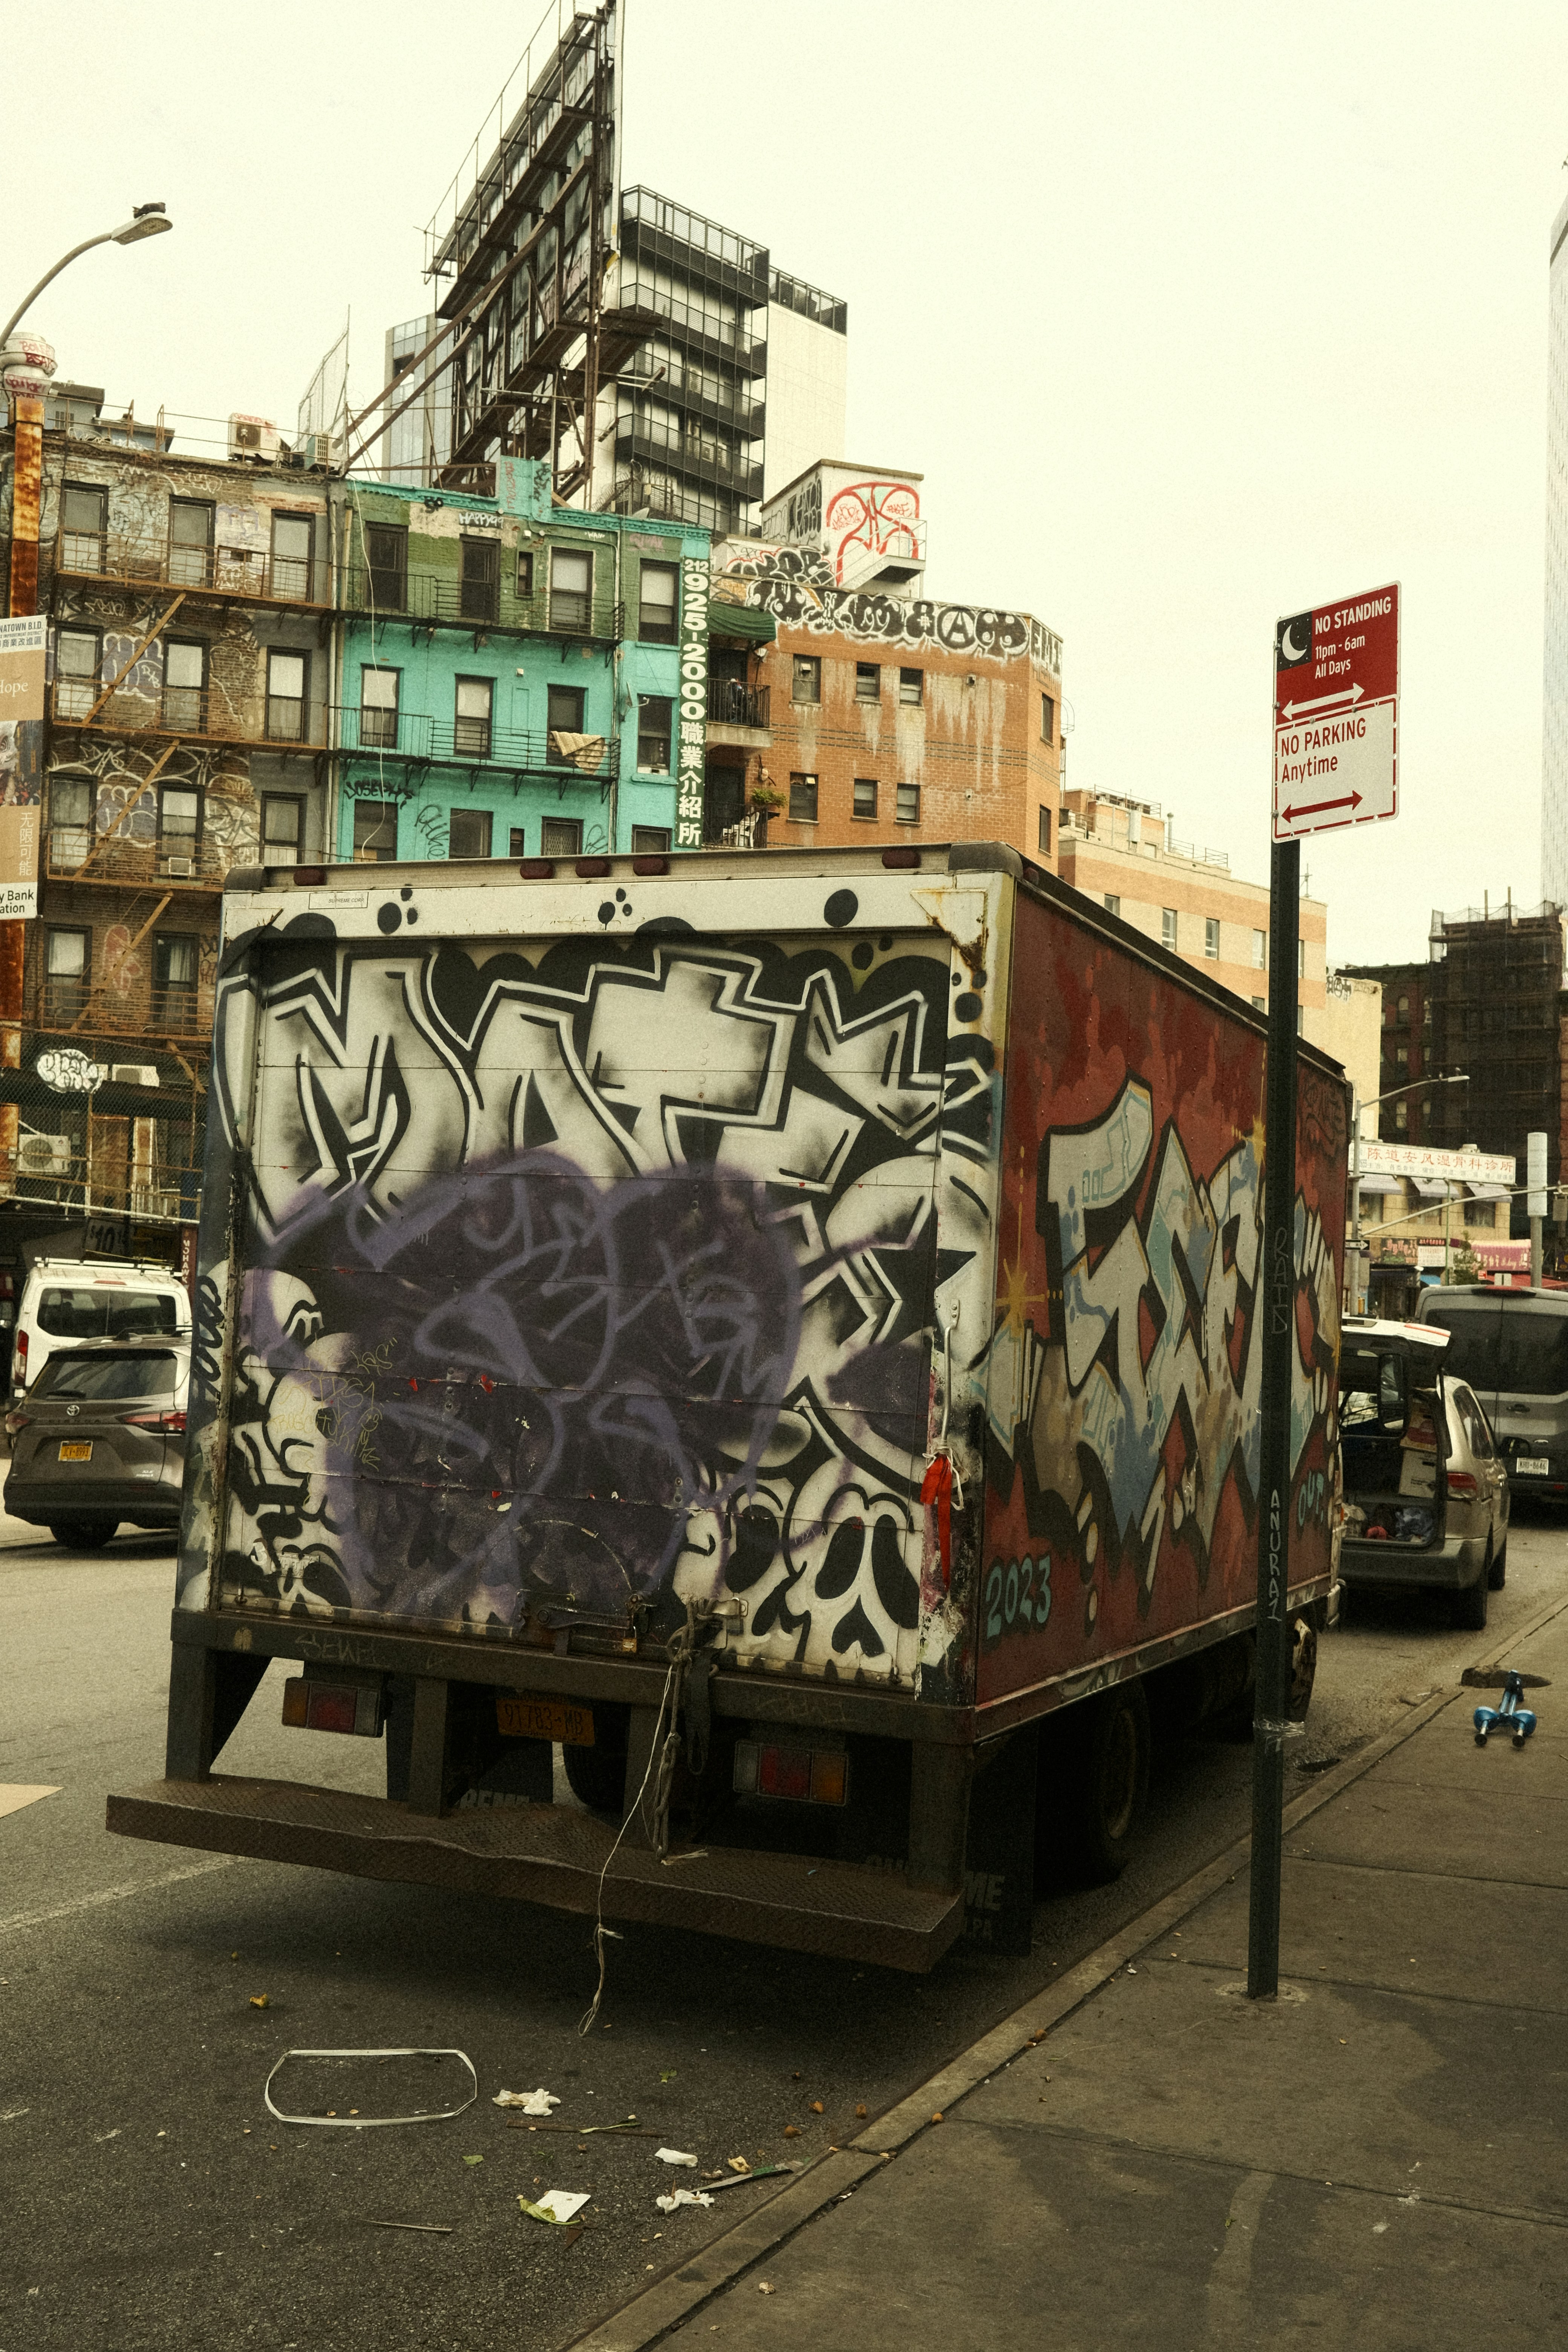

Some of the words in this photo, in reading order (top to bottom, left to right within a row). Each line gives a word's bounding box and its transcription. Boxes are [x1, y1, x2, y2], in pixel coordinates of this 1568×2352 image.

[684, 559, 709, 572] 212
[1315, 615, 1331, 635] NO
[1334, 596, 1391, 629] STANDING
[681, 573, 709, 720] 925-2000
[1315, 644, 1336, 661] 11pm
[1344, 635, 1365, 651] 6am
[1315, 663, 1326, 679] All
[1329, 659, 1351, 675] Days
[1282, 735, 1299, 757] NO
[1305, 718, 1366, 751] PARKING
[678, 721, 705, 846] 職業介紹所
[1282, 756, 1338, 783] Anytime
[19, 812, 34, 876] 无限可能
[8, 889, 34, 901] Bank
[986, 1554, 1052, 1640] 2023
